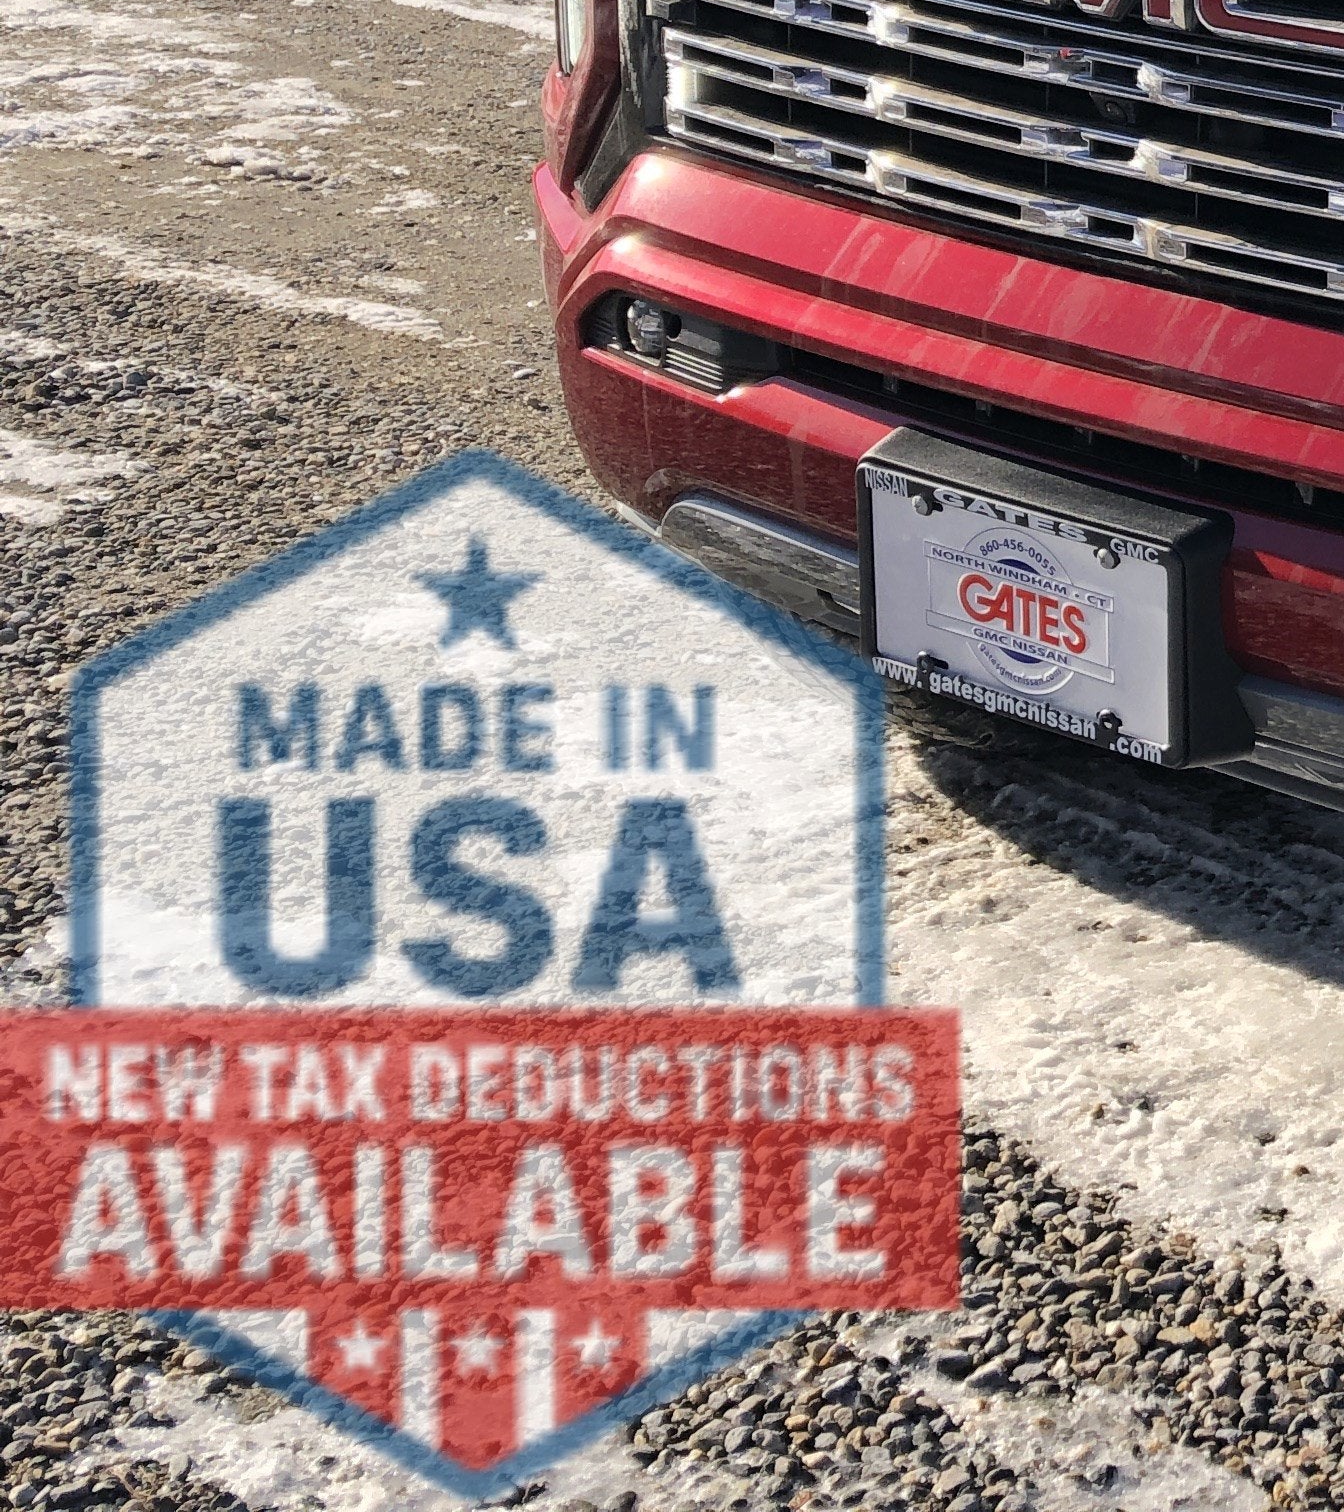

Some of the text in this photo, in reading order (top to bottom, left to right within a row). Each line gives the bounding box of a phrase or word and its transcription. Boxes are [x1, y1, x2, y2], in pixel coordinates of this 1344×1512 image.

[865, 468, 1160, 564] NISSAN GATES GMC
[932, 547, 1107, 607] NORTH WINDHAM CT
[979, 538, 1057, 576] 860-456-0055
[958, 574, 1088, 655] GATES
[973, 627, 1068, 665] GMC NISSAN
